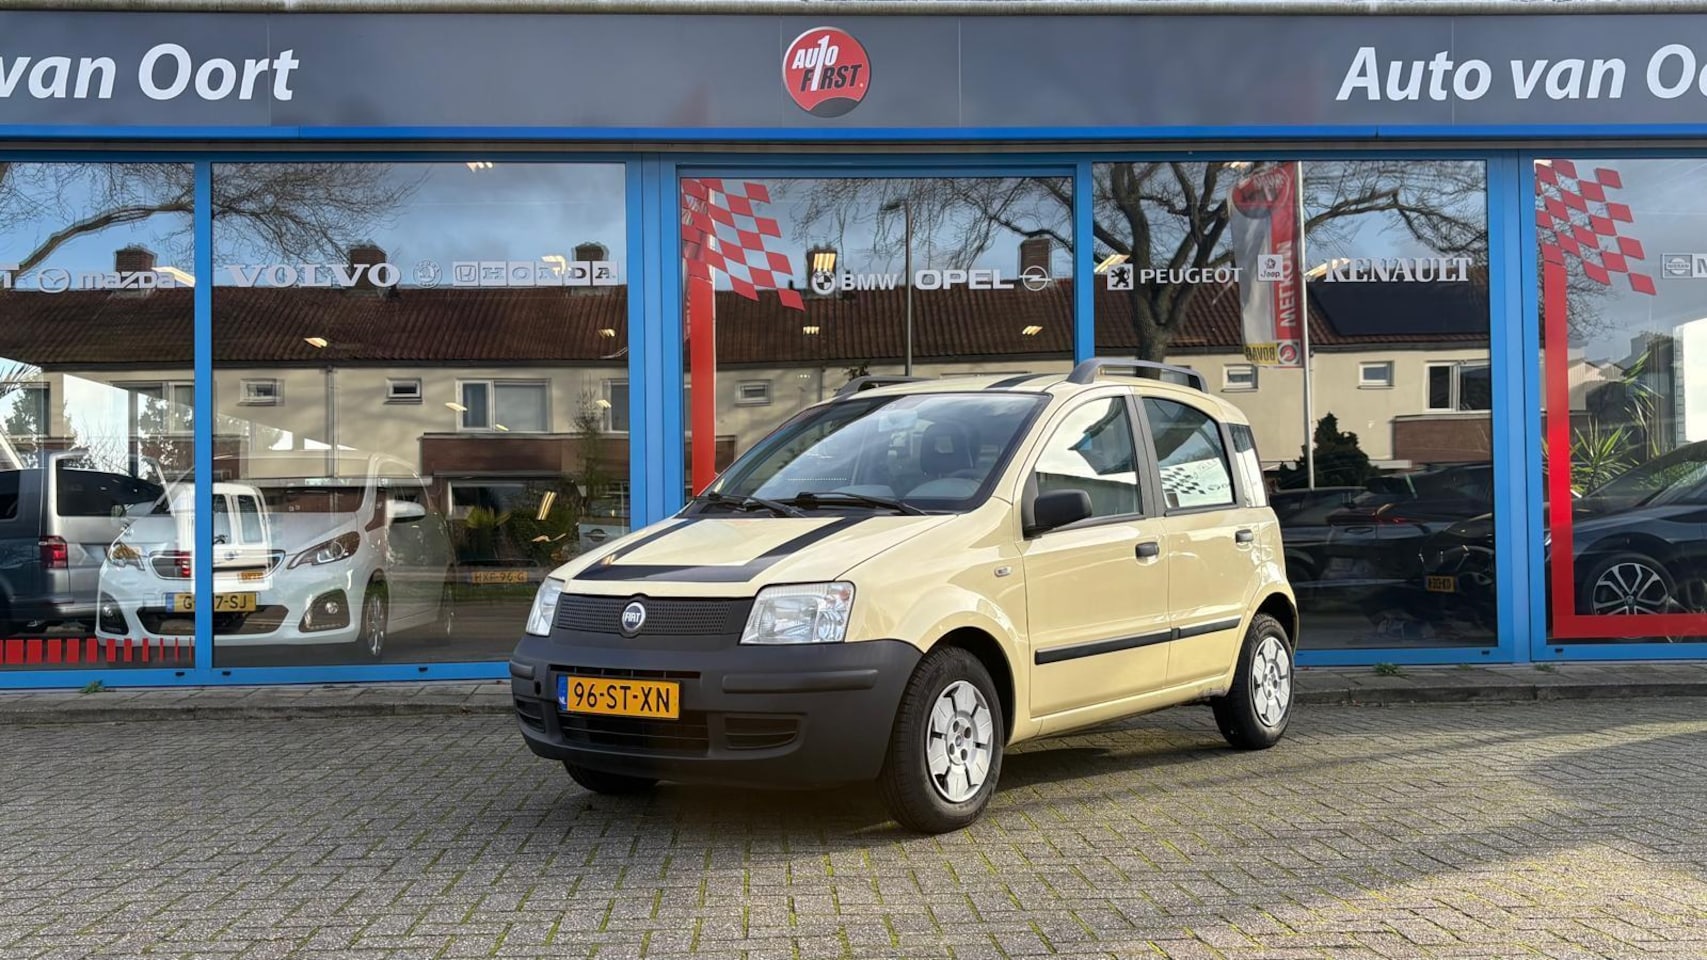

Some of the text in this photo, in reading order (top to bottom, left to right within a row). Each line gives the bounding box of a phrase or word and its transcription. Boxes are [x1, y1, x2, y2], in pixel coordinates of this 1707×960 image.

[0, 43, 300, 101] van Oort
[1335, 46, 1493, 101] Auto
[1510, 58, 1626, 100] van
[223, 262, 401, 288] VOLVO
[481, 265, 615, 281] HONDA
[840, 272, 898, 291] BMW
[914, 269, 1015, 290] OPEL
[1139, 267, 1244, 285] PEUGEOT
[1323, 257, 1473, 283] RENAULT
[623, 612, 641, 623] FIAT
[573, 681, 670, 713] 96-ST-XN
